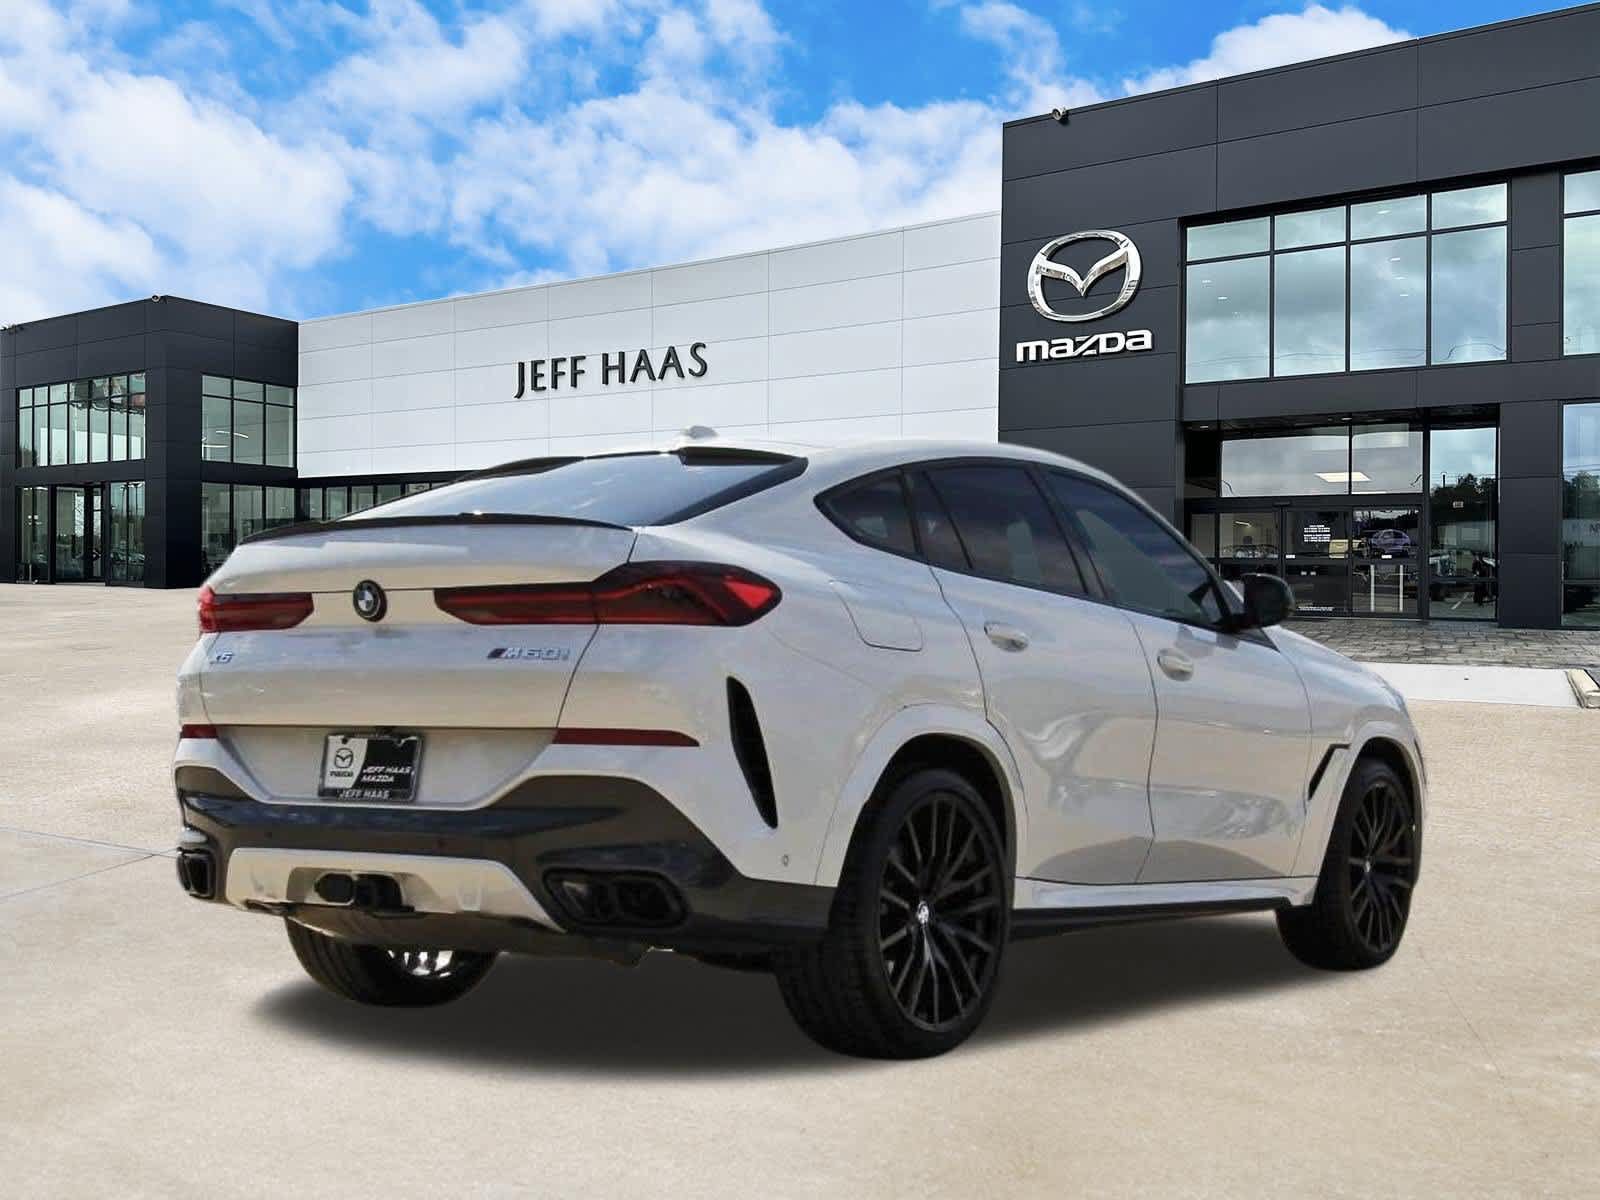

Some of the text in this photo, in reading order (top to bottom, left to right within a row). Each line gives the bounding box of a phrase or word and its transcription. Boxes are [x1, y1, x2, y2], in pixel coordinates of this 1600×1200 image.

[1016, 329, 1153, 362] mazda
[514, 342, 708, 399] JEFF HAAS
[362, 766, 412, 774] JEFF HAAS
[340, 789, 390, 799] JEFF HAAS
